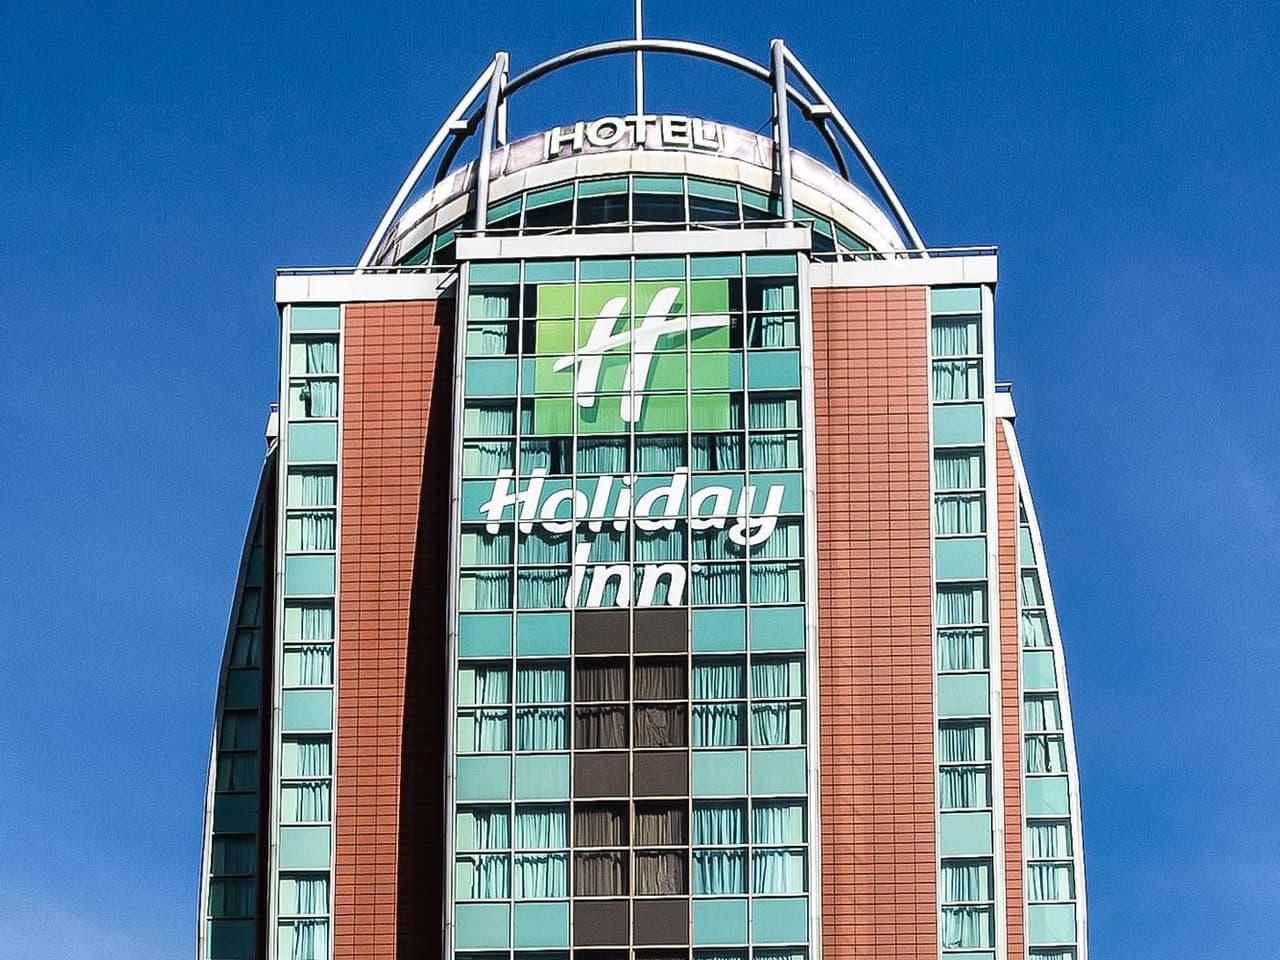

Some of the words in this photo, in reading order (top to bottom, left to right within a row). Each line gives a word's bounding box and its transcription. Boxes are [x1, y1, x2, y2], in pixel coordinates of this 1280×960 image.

[546, 114, 723, 160] HOTEL
[479, 467, 786, 546] Holiday
[564, 544, 688, 607] Inn
